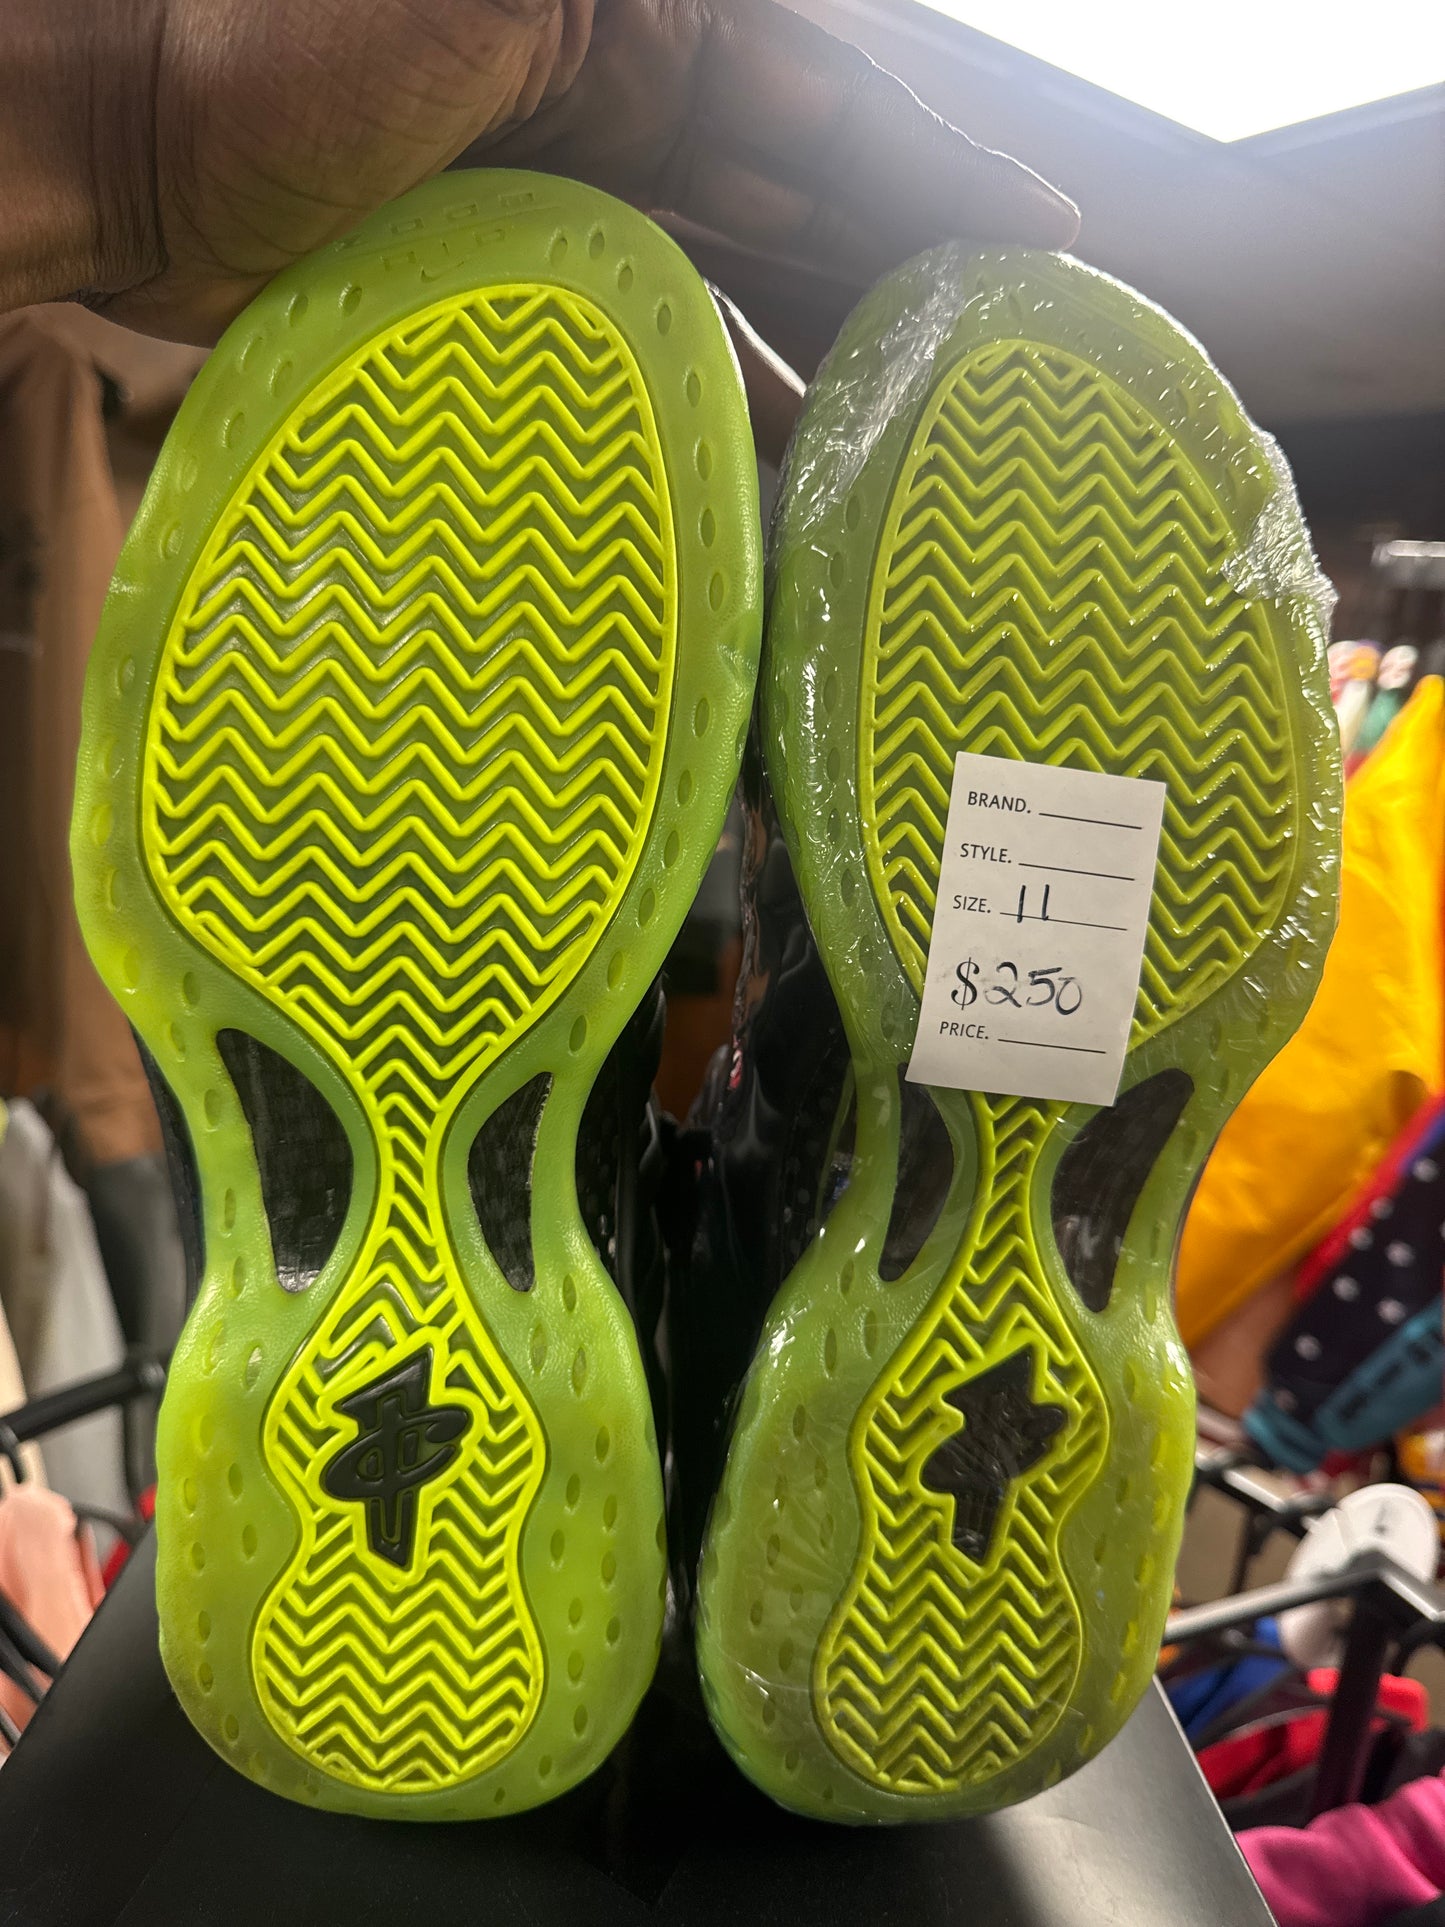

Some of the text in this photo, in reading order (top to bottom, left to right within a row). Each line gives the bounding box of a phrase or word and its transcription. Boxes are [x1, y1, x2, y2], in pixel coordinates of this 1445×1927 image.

[967, 790, 1032, 814] BRAND.
[959, 842, 1012, 864] STYLE.
[952, 884, 1050, 923] SIZE. 11
[950, 956, 1083, 1016] $250
[939, 1020, 989, 1040] PRICE.
